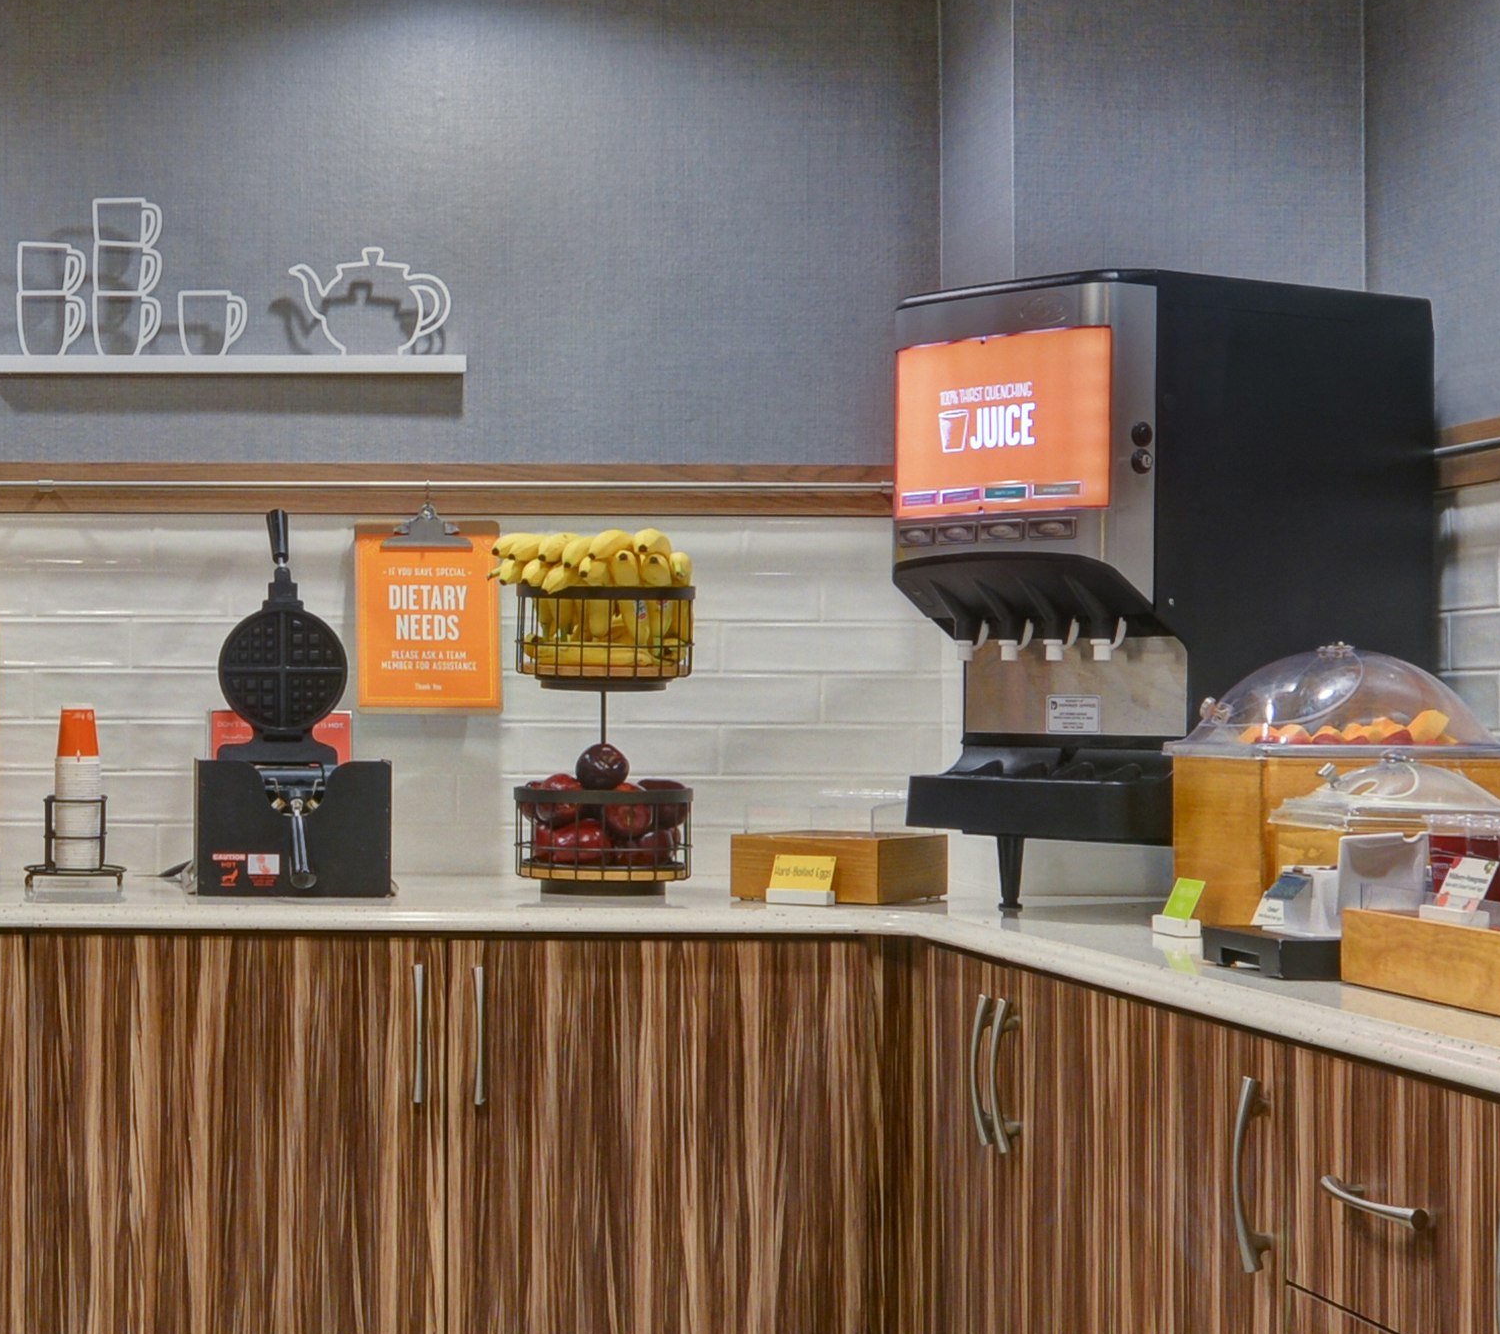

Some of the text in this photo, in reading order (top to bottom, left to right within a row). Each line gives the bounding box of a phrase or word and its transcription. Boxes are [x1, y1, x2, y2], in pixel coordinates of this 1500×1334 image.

[970, 402, 1036, 450] JUICE
[388, 568, 395, 576] IF
[397, 568, 412, 576] YOU
[436, 568, 466, 577] SPECIAL
[388, 584, 468, 611] DIETARY
[395, 614, 460, 641] NEEDS
[391, 650, 419, 660] PLEASE
[421, 650, 436, 660] ASK
[446, 650, 467, 660] TEAM
[381, 660, 477, 671] MEMBER FOR ASSISTANCE
[212, 853, 247, 861] CAUTION
